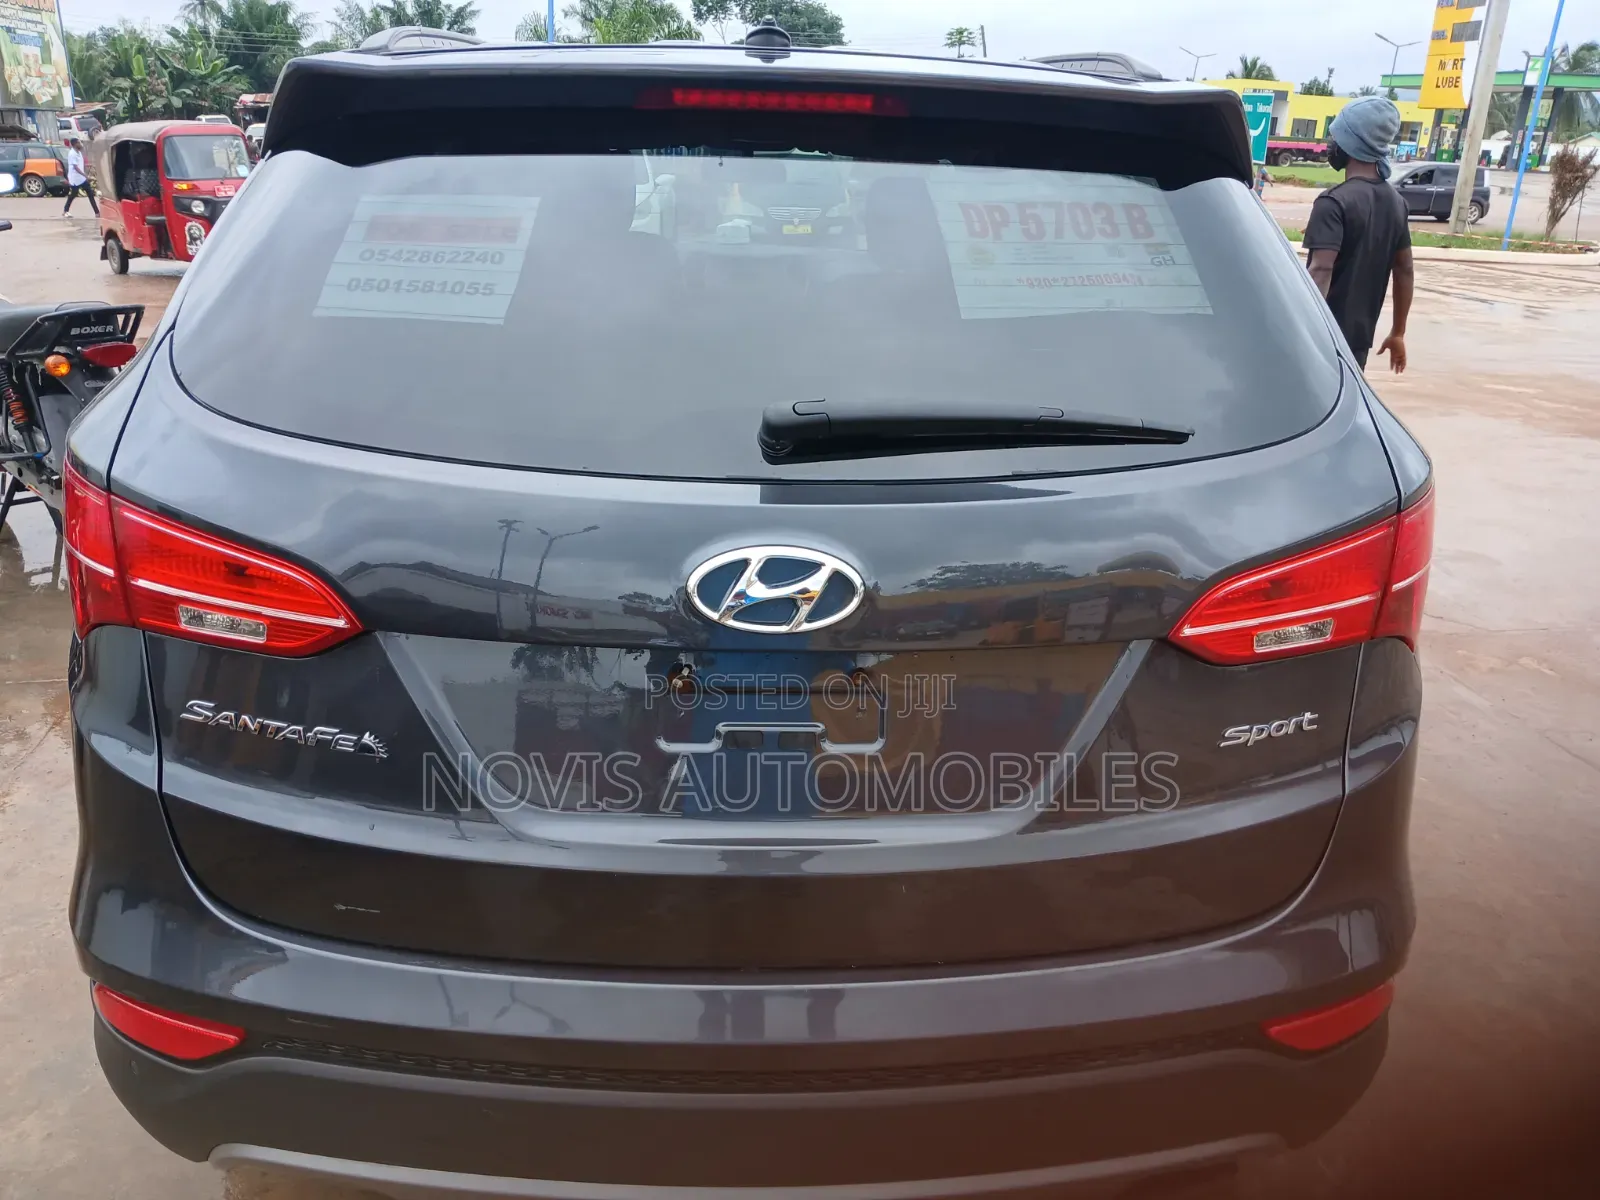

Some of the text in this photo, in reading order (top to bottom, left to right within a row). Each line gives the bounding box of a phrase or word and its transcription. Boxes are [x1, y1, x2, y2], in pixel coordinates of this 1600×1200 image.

[1435, 76, 1461, 89] LUBE
[959, 201, 1156, 242] DP 5703 B
[1150, 254, 1176, 267] GH
[346, 277, 498, 297] 0501581055
[70, 325, 114, 336] BOXER
[1218, 711, 1319, 748] Sport
